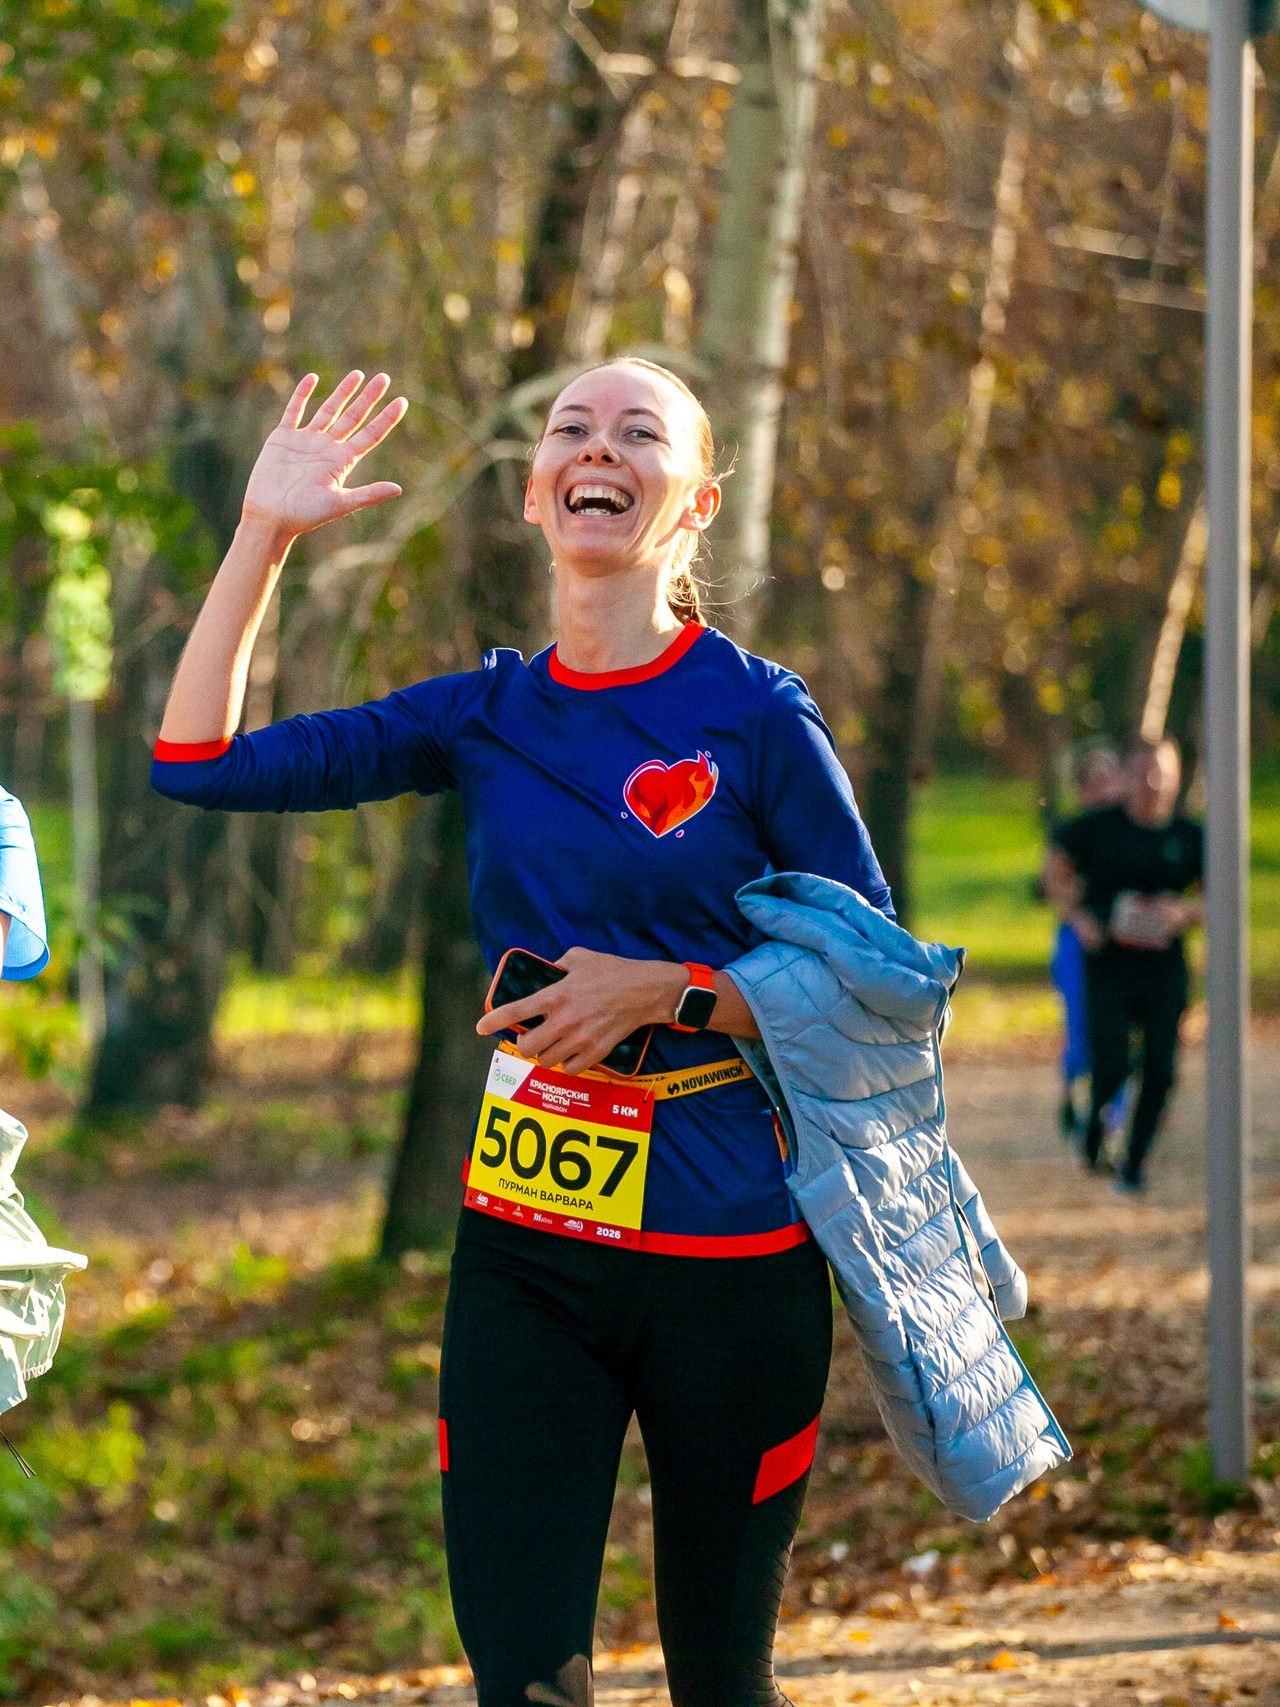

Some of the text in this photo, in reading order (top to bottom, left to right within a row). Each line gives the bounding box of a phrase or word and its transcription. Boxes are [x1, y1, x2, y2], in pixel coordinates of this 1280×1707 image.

[501, 1073, 517, 1086] СБЕР
[681, 1066, 744, 1091] NOVAWINCH
[530, 1079, 590, 1101] КРАСНОЯРСКИЕ
[542, 1092, 570, 1106] МОСТЫ
[612, 1104, 638, 1118] 5 КМ
[479, 1106, 639, 1198] 5067
[498, 1178, 594, 1211] ПУРМАН ВАРВАРА
[596, 1226, 621, 1239] 2026
